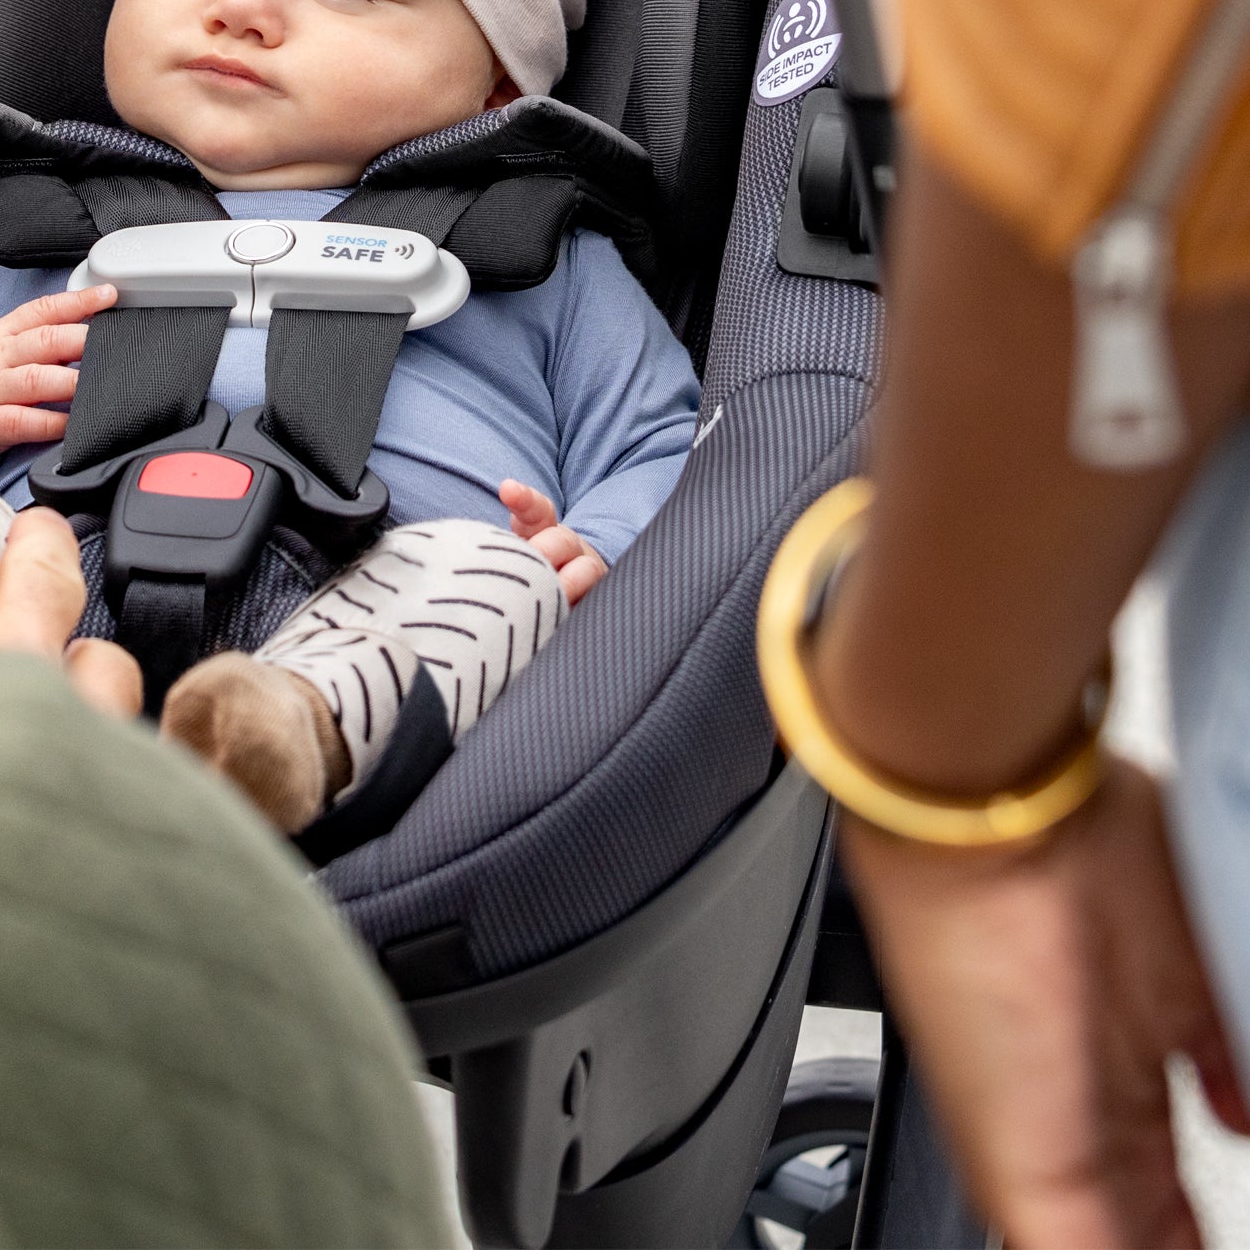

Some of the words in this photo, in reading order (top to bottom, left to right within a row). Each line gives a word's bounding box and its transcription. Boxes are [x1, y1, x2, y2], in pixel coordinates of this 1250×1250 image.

[758, 61, 782, 87] SIDE
[782, 42, 833, 70] IMPACT
[767, 63, 814, 91] TESTED
[325, 234, 388, 248] SENSOR
[320, 245, 385, 263] SAFE
